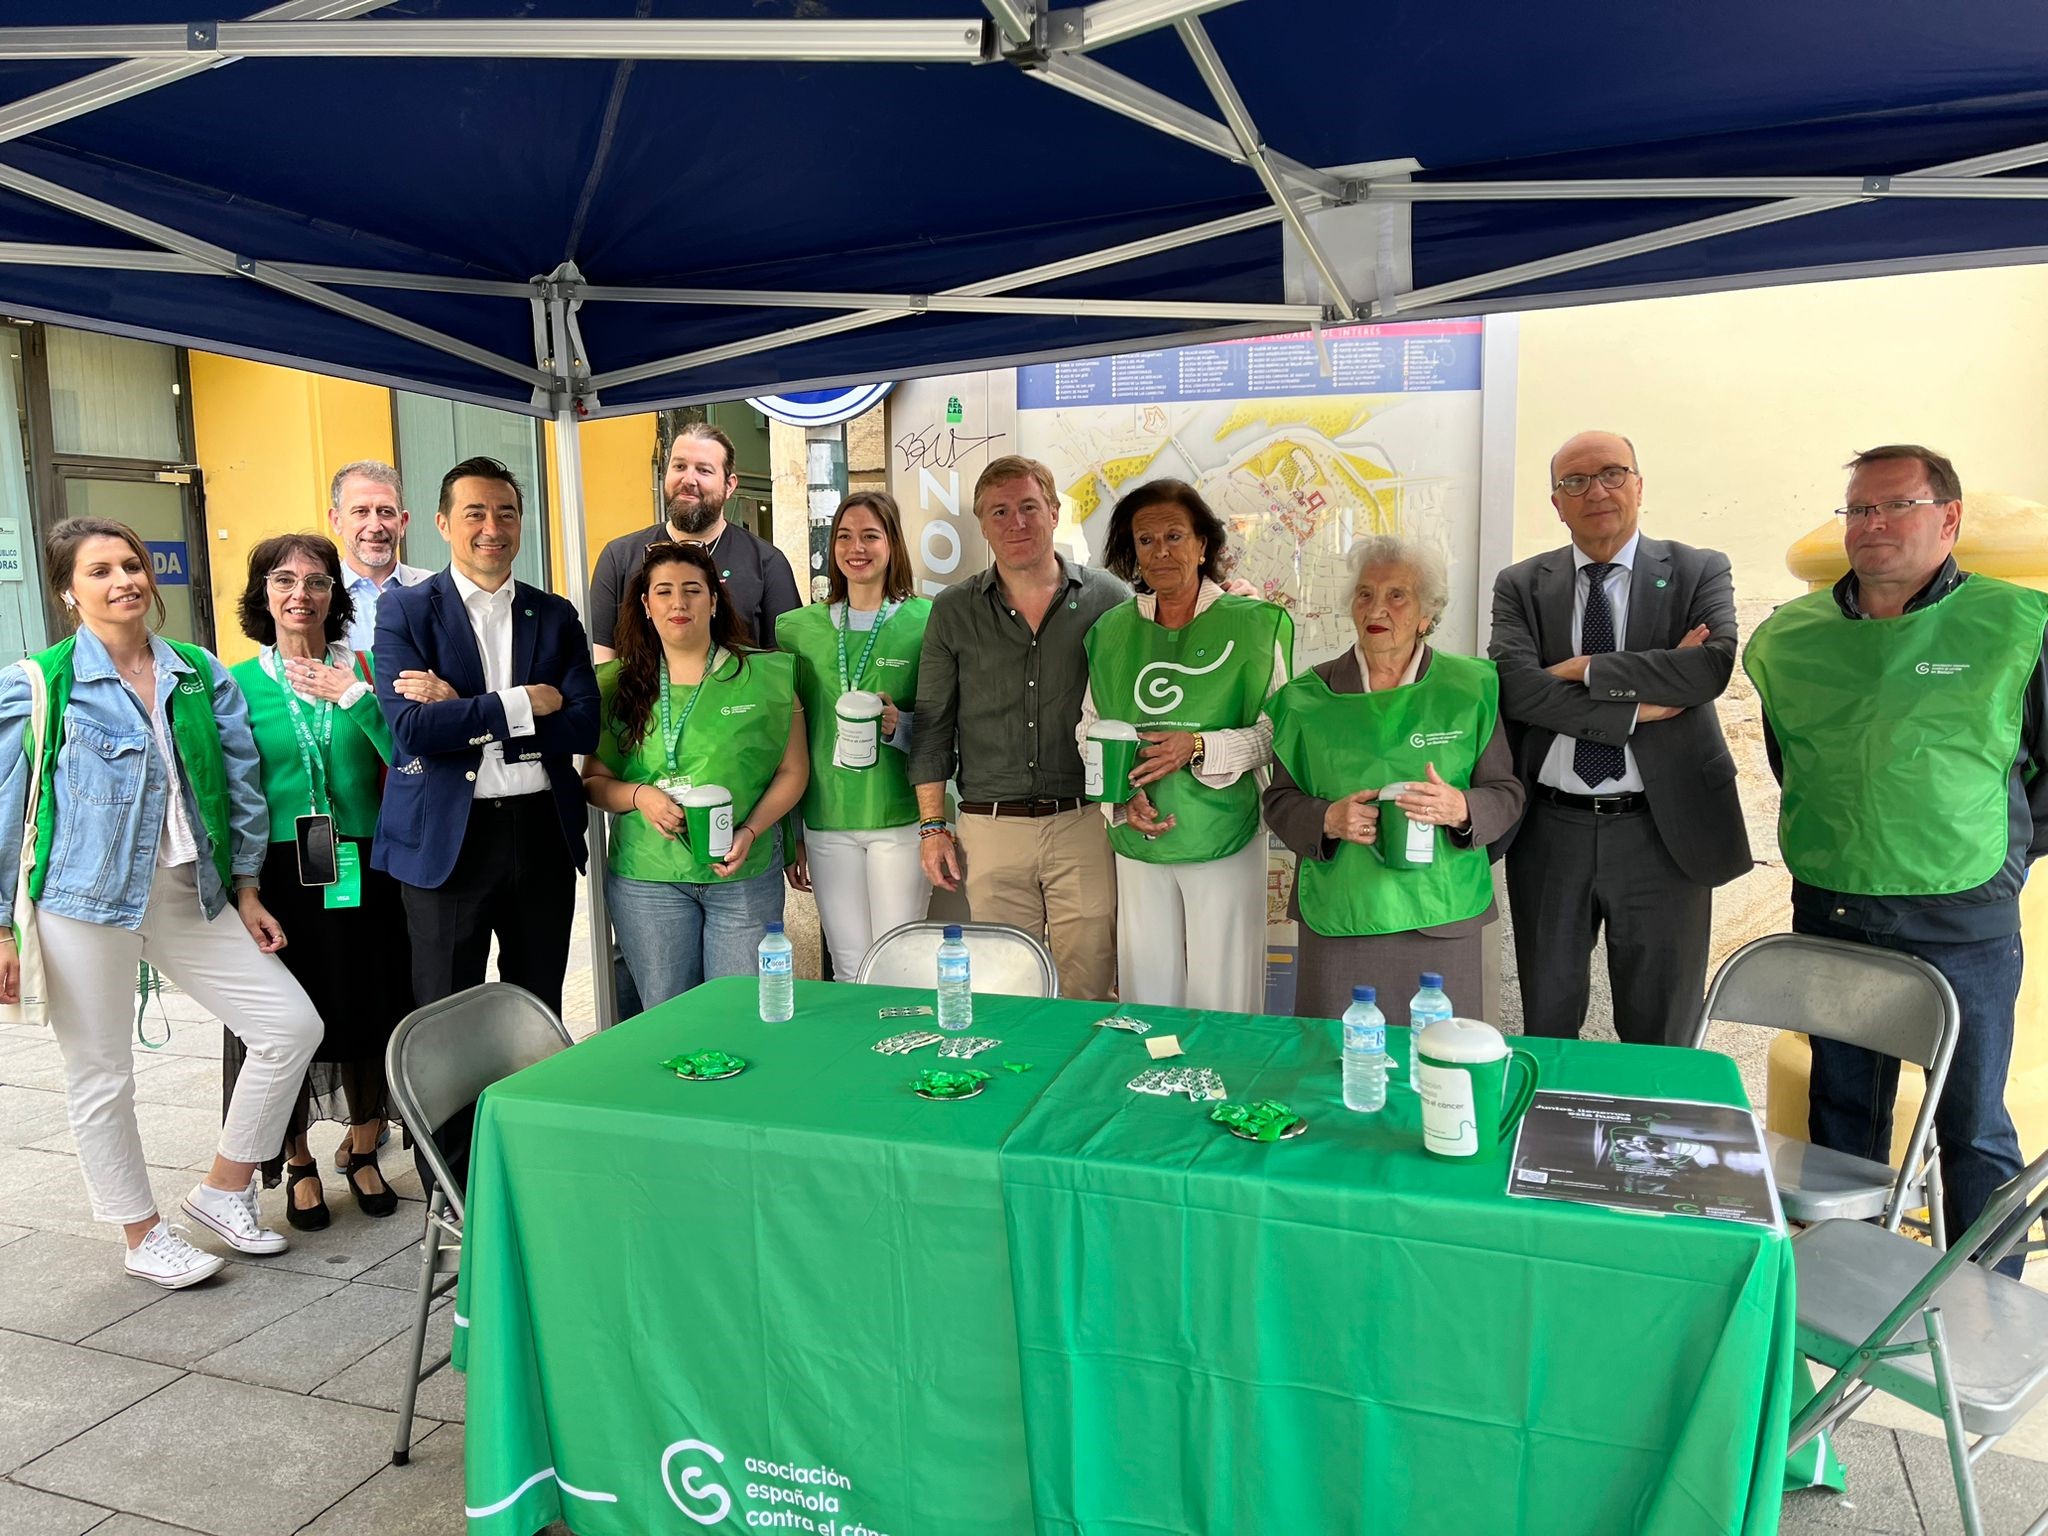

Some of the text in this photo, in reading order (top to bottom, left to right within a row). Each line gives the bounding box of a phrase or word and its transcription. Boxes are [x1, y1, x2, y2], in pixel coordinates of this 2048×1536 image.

[744, 1457, 851, 1491] asociación
[745, 1482, 839, 1513] española
[745, 1509, 890, 1536] contra el cán
